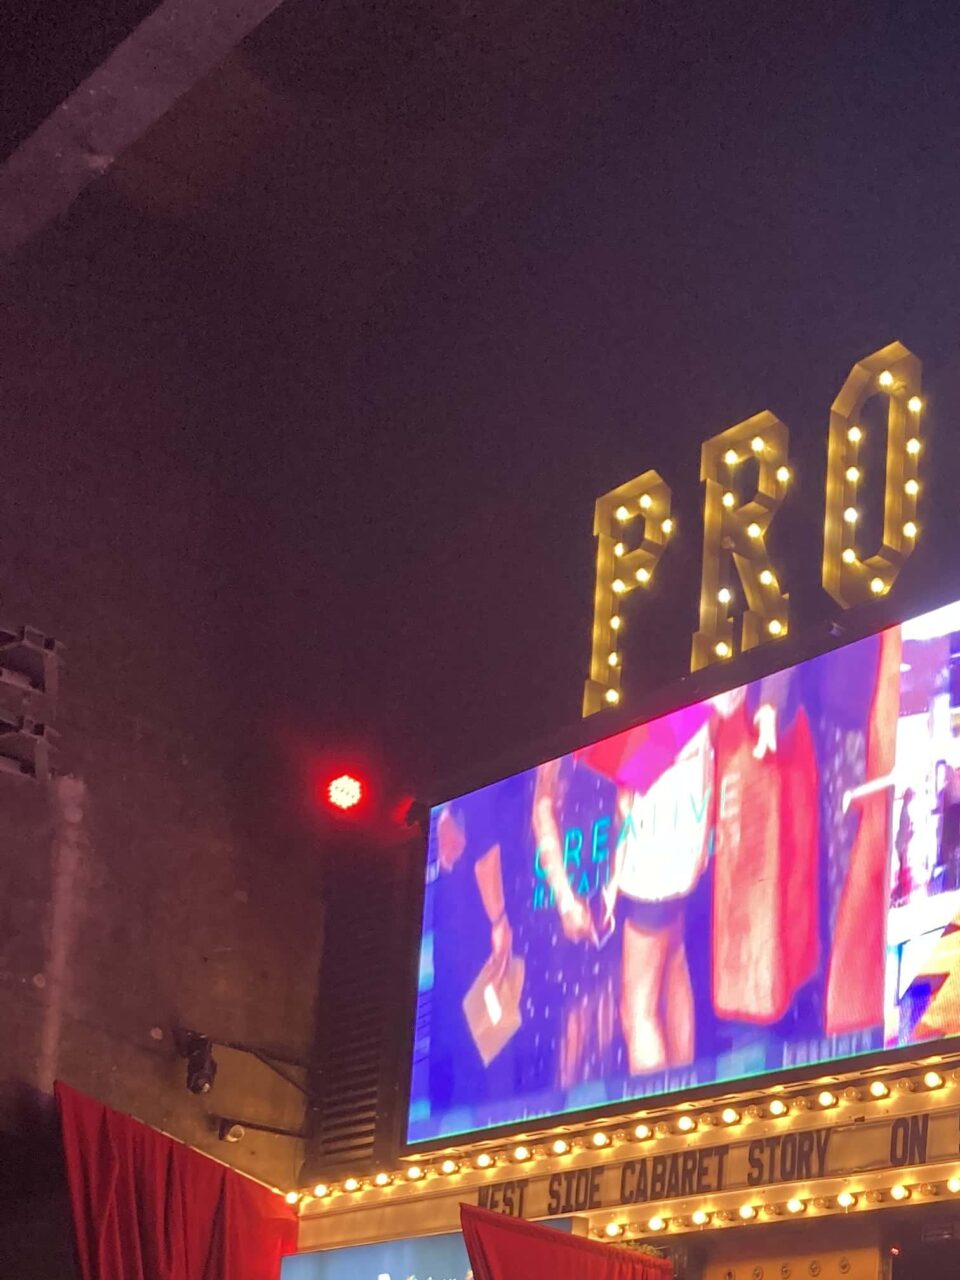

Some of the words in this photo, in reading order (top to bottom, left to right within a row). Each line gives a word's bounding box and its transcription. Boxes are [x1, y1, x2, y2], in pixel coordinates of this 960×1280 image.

[547, 1165, 605, 1215] SIDE
[620, 1146, 731, 1207] CABARET
[747, 1129, 833, 1186] STORY
[889, 1113, 930, 1167] ON
